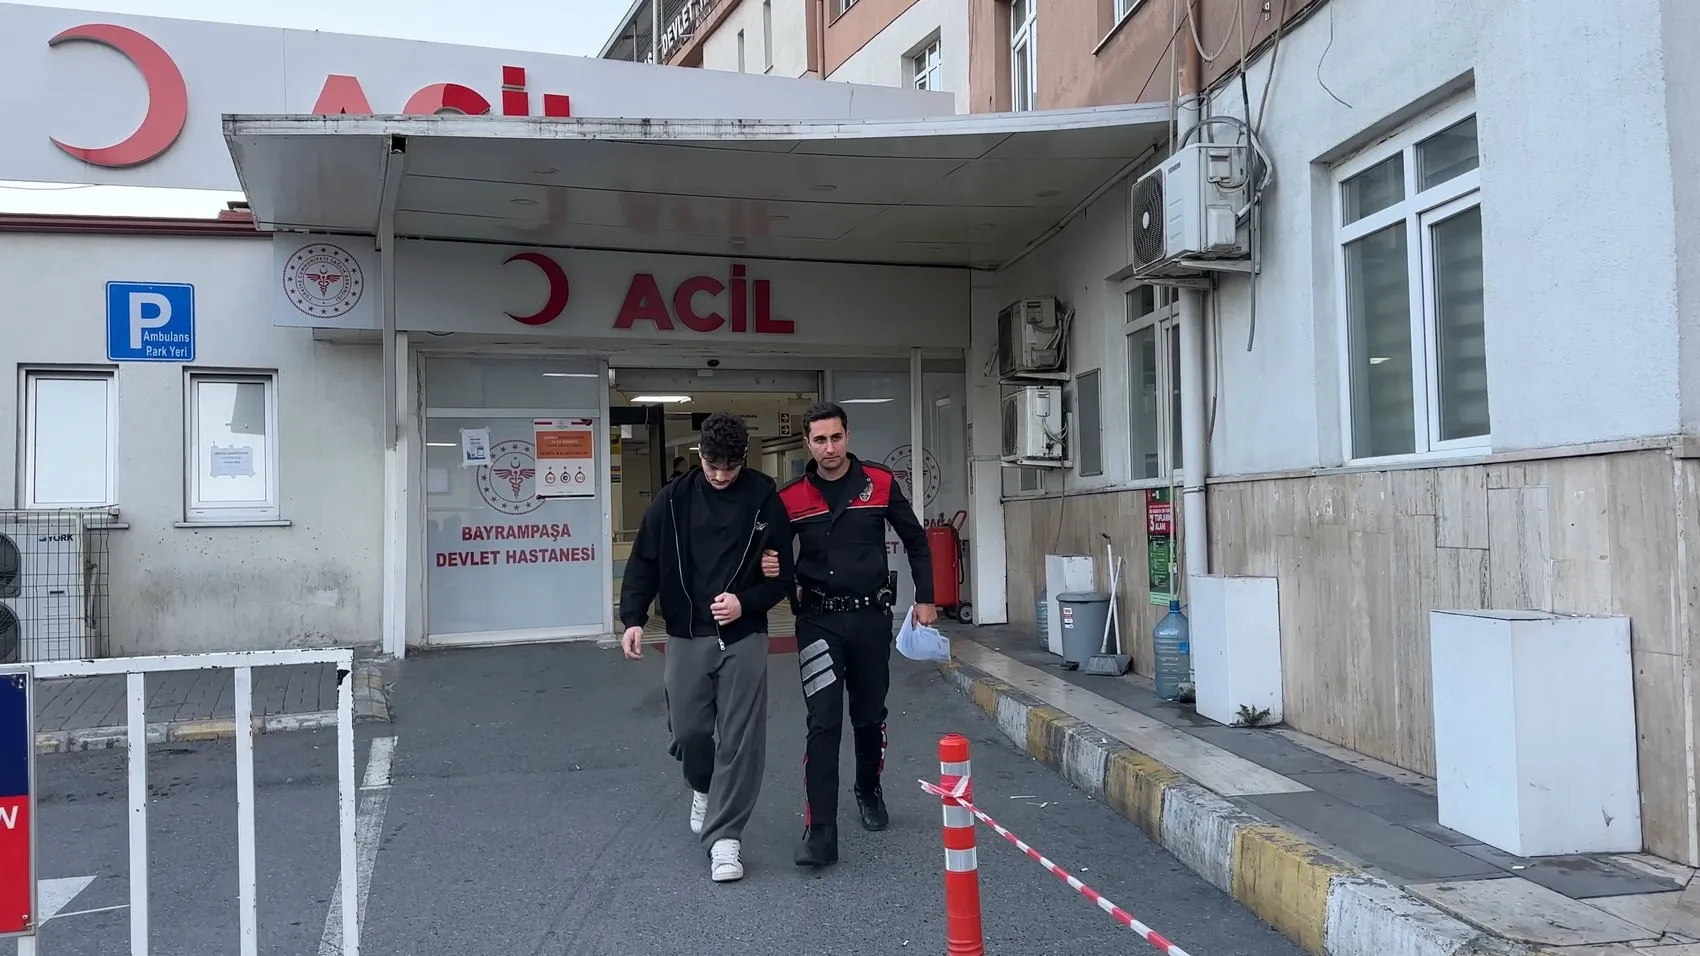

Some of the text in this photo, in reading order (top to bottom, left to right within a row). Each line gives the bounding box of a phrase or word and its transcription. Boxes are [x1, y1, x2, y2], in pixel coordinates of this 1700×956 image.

[612, 264, 795, 334] ACİL
[129, 292, 172, 349] P
[143, 331, 190, 342] Ambulans
[146, 346, 188, 357] Park Yeri
[462, 523, 572, 542] BAYRAMPAŞA
[436, 543, 595, 567] DEVLET HASTANESİ
